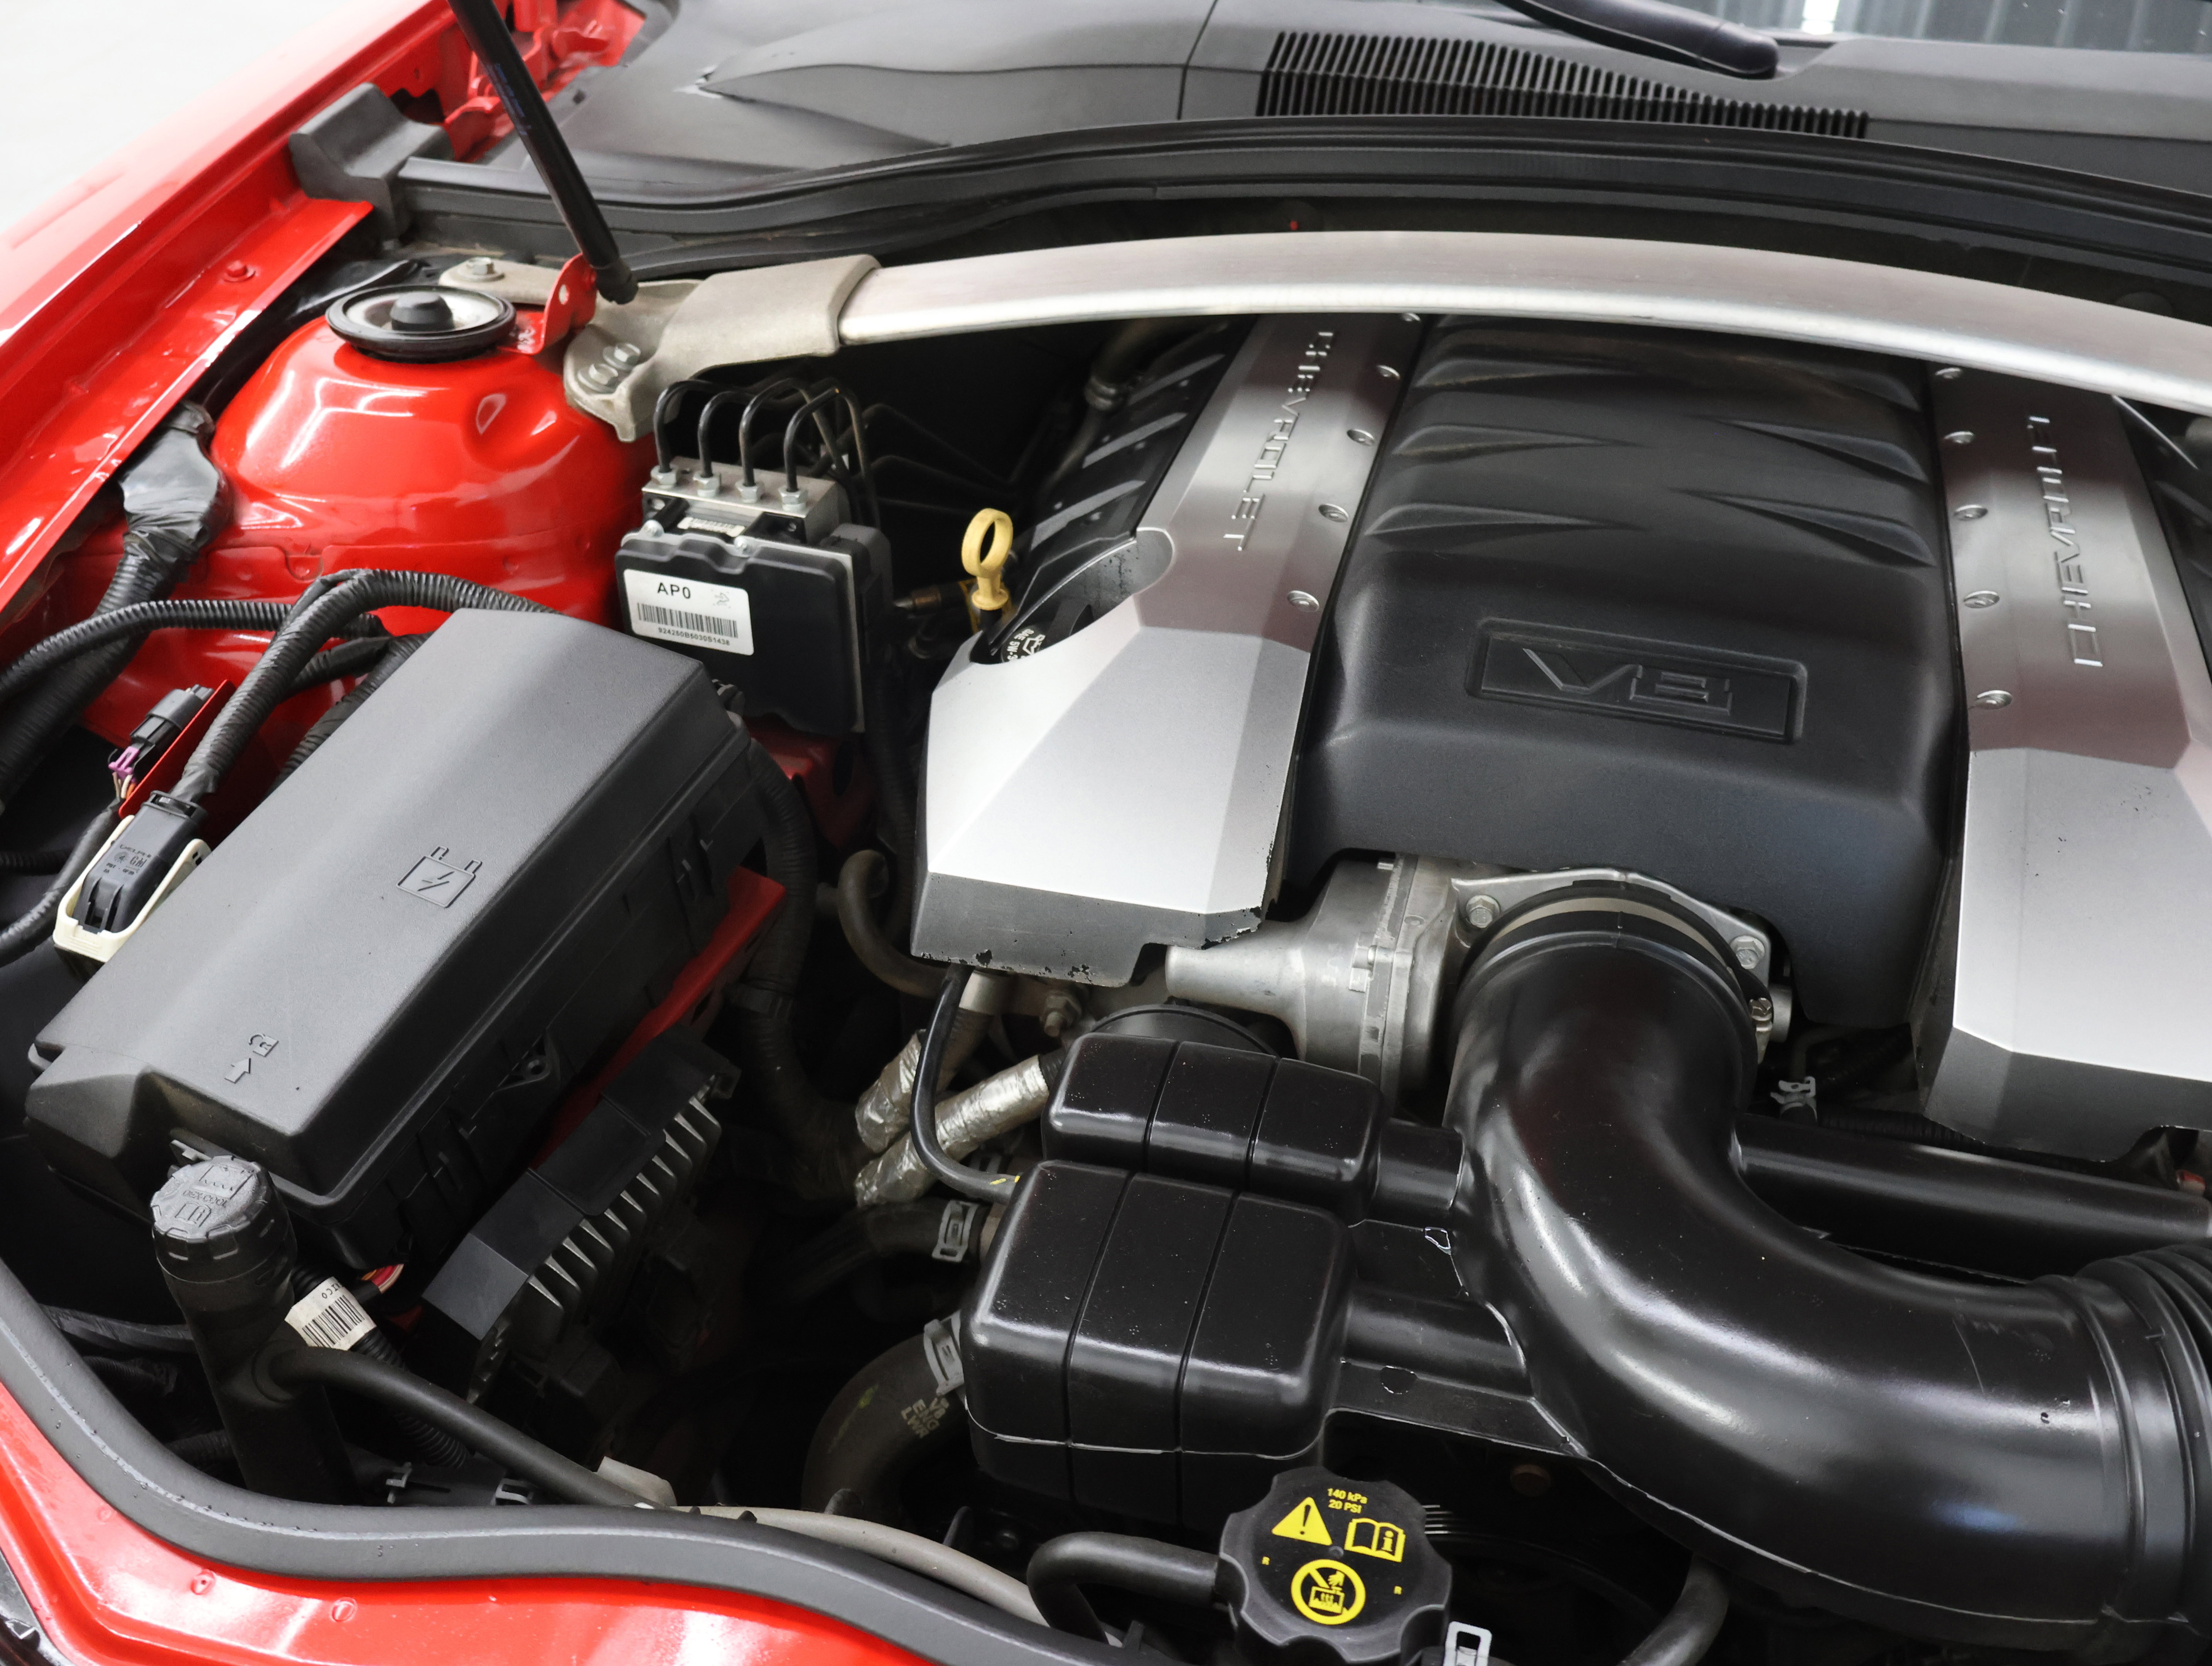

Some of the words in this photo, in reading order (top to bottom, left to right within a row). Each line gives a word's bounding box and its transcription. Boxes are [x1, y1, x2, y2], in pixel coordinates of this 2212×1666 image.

[1223, 331, 1334, 551] CHEVROLET
[2026, 414, 2103, 667] CHEVROLET
[1014, 629, 1034, 641] SAE
[1007, 641, 1021, 661] 5W-3
[1522, 648, 1731, 715] V8
[1327, 1488, 1346, 1500] 140
[1346, 1491, 1368, 1504] kPa
[1328, 1499, 1341, 1510] 20
[1343, 1502, 1362, 1514] PSI
